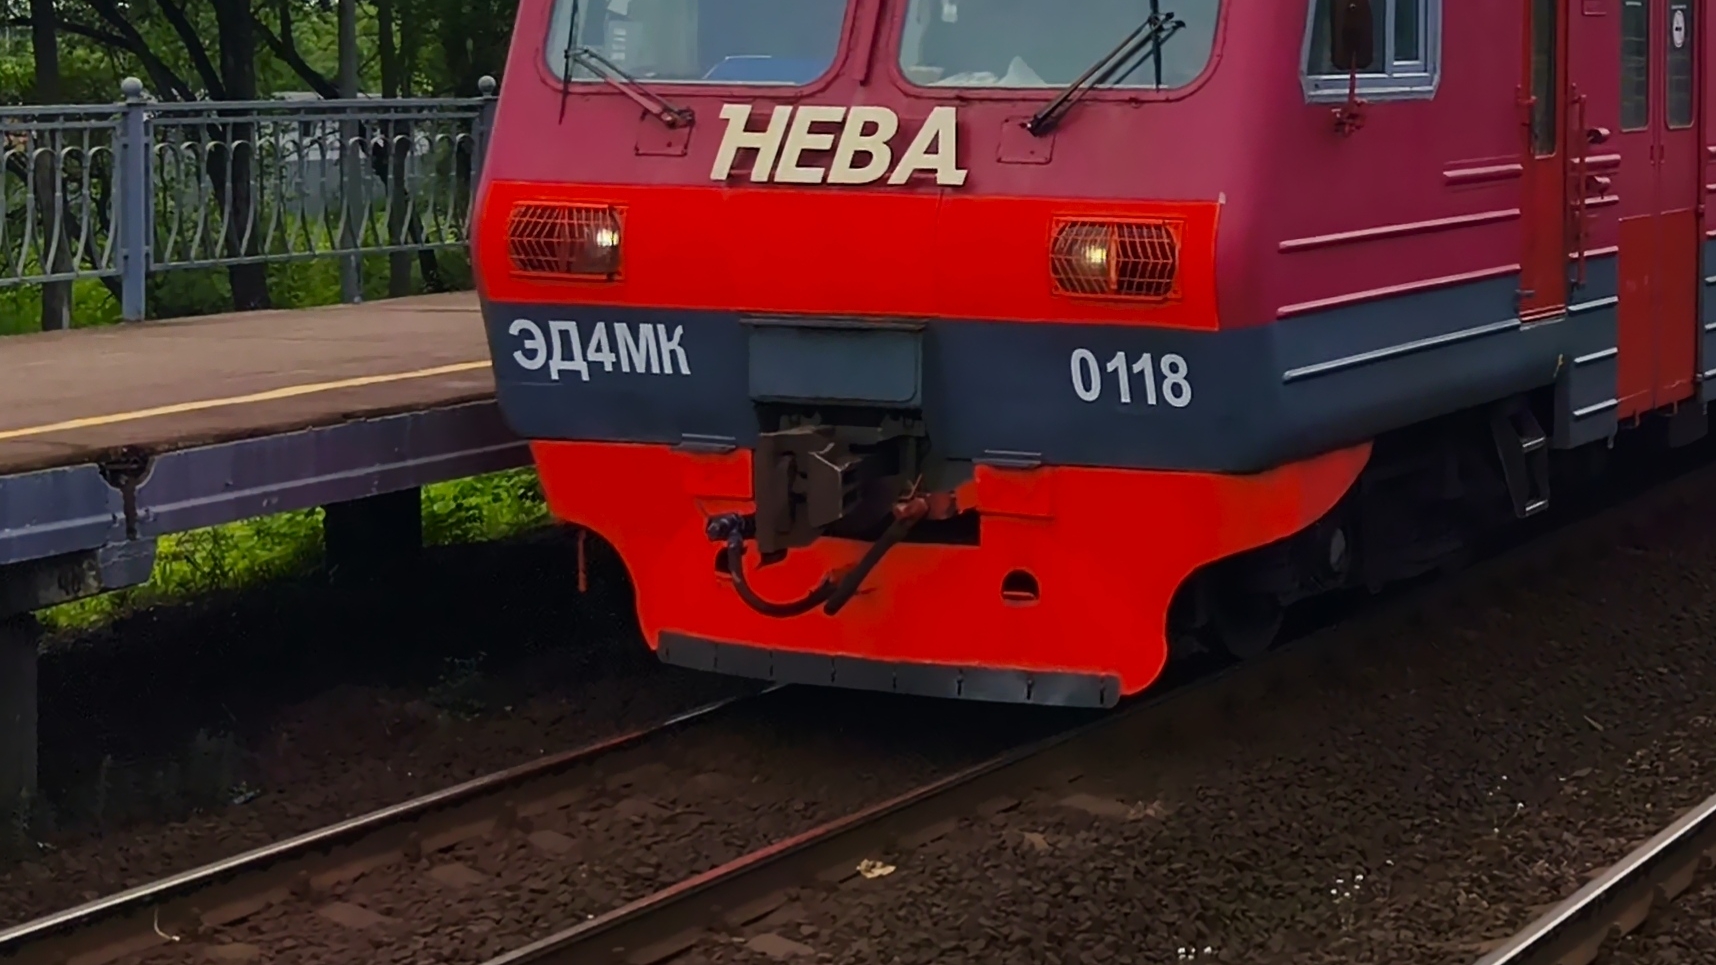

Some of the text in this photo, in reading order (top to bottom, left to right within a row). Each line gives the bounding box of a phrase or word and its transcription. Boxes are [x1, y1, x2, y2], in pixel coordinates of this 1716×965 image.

[710, 104, 968, 185] НЕВА
[508, 318, 691, 381] ЭД4МК
[1071, 348, 1192, 407] 0118
